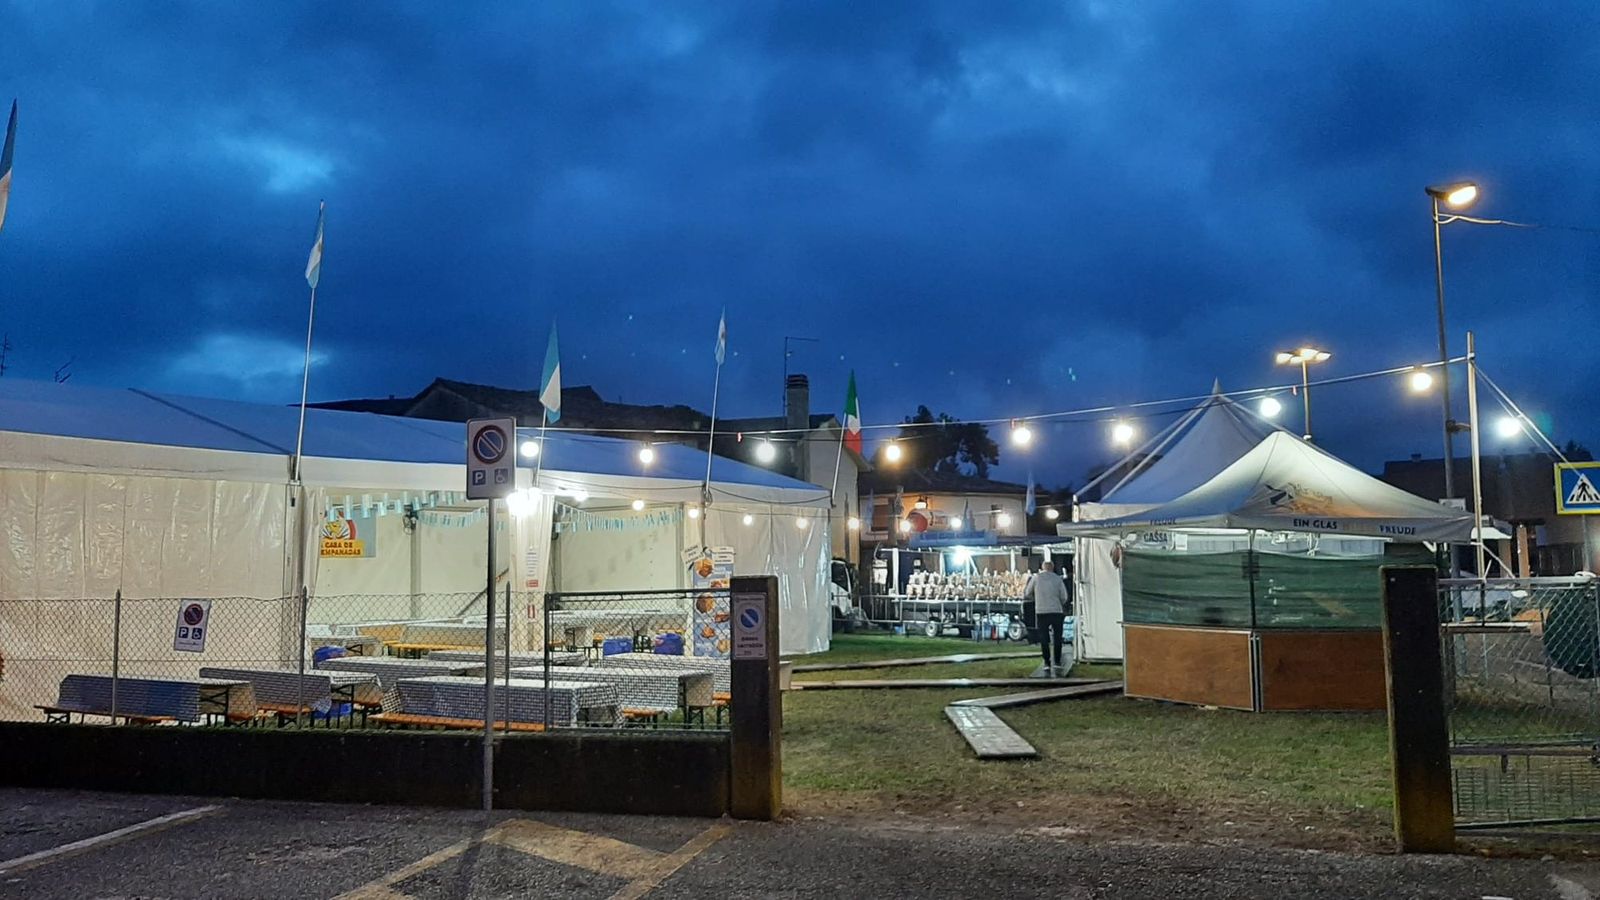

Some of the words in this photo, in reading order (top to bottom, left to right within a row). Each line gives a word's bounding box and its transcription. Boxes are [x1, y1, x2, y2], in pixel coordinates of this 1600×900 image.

[475, 472, 484, 484] P
[1293, 519, 1310, 528] EIN
[1313, 520, 1338, 530] GLAS
[1380, 525, 1416, 536] FREUDE
[1143, 530, 1168, 543] CASSA
[180, 628, 187, 638] P
